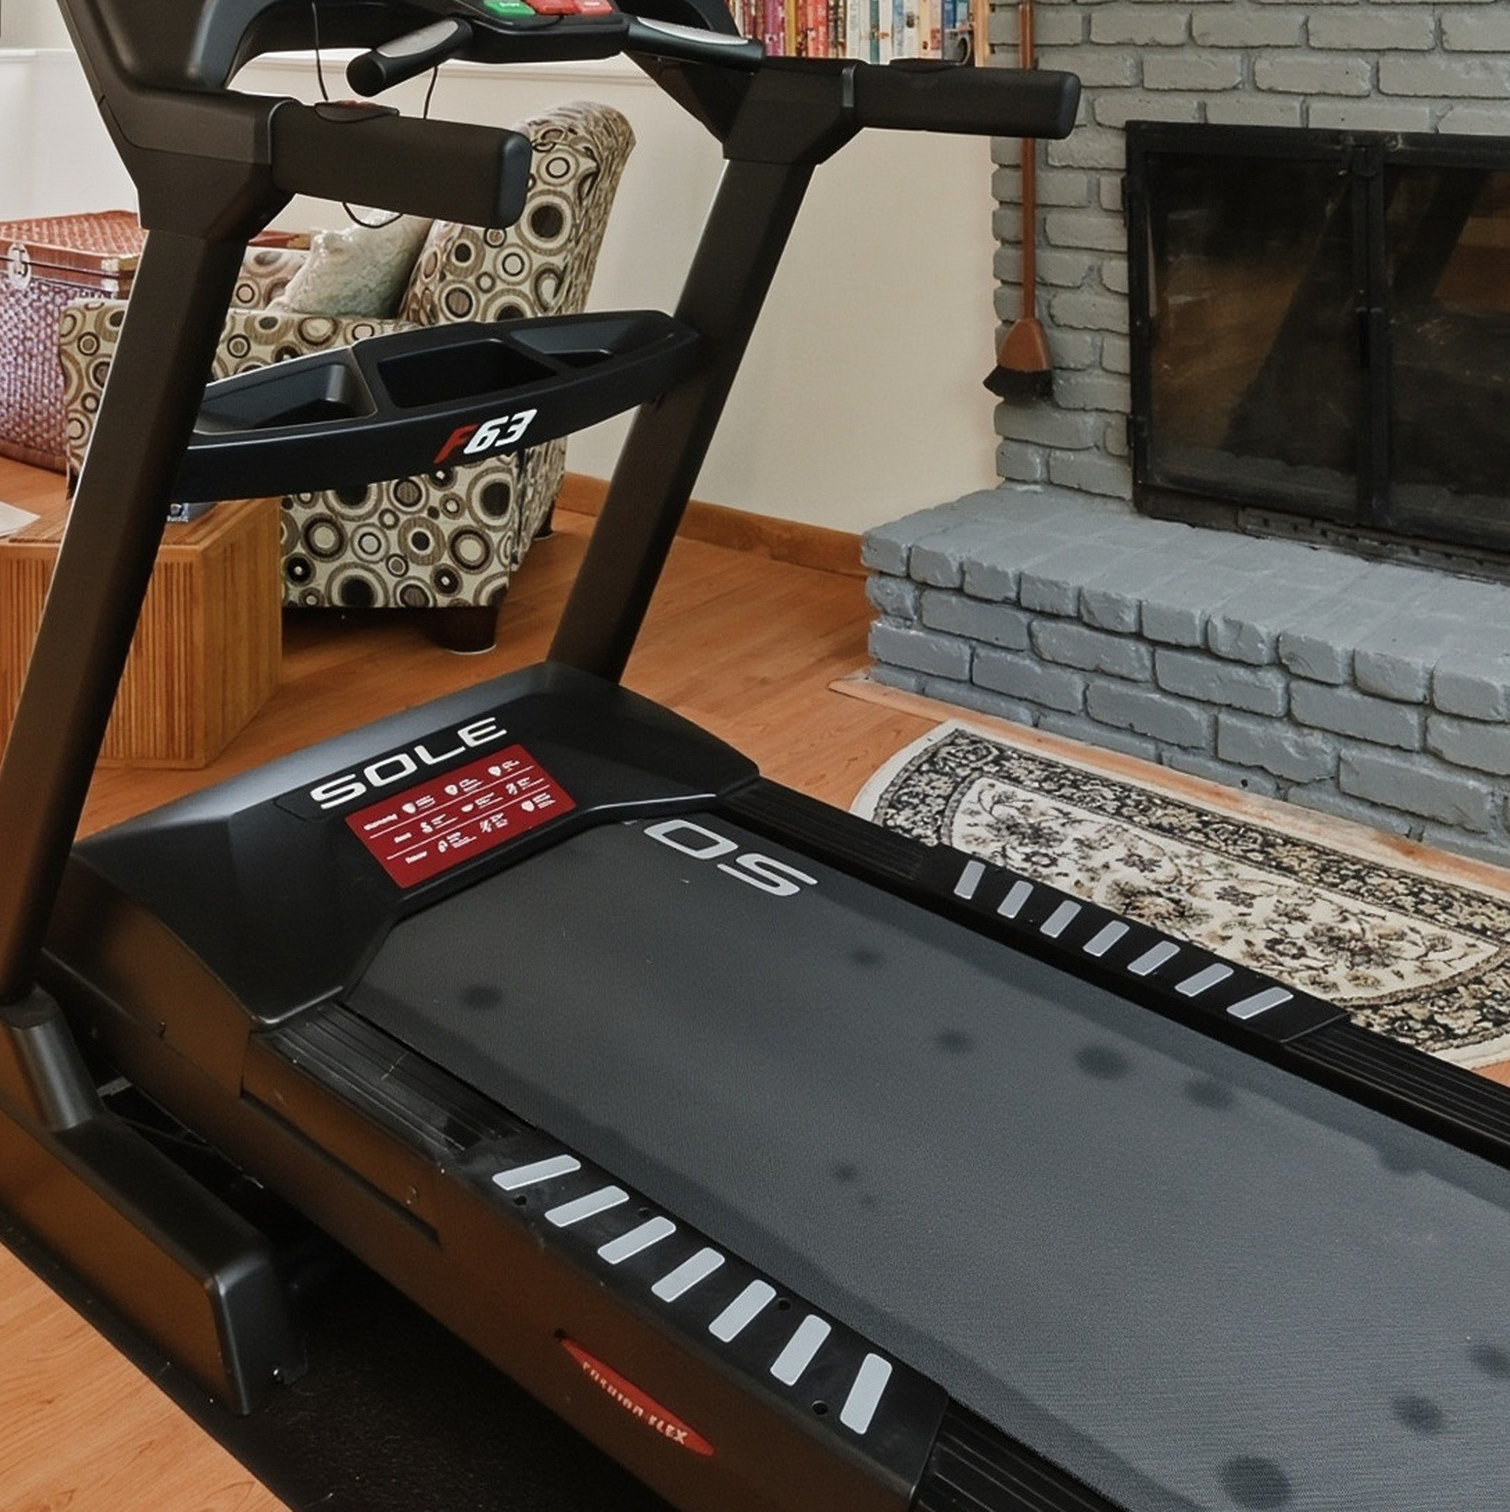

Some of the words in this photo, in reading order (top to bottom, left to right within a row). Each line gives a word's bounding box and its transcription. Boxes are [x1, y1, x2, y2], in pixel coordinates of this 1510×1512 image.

[434, 409, 538, 463] F63
[310, 716, 507, 810] SOLE
[648, 1414, 688, 1445] FLEX
